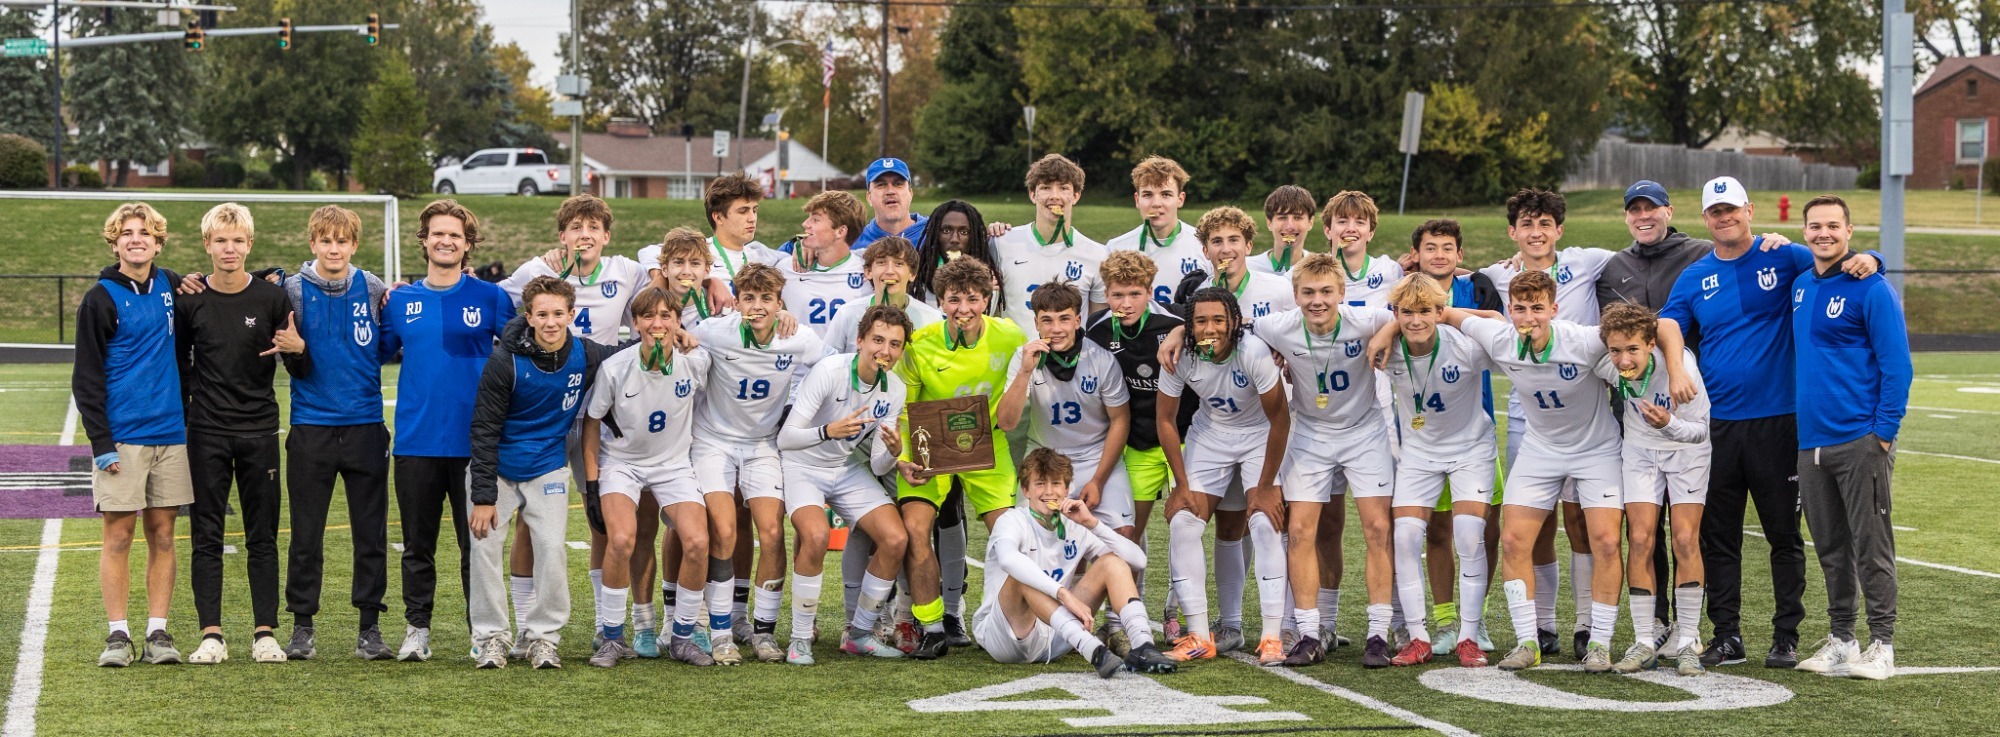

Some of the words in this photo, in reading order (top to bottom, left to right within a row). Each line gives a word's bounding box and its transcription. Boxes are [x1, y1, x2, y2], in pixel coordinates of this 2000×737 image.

[1702, 273, 1719, 290] CH
[161, 292, 173, 306] 29
[353, 302, 368, 317] 24
[406, 301, 422, 316] RD
[574, 307, 592, 335] 4
[1109, 341, 1121, 350] 33
[567, 373, 582, 387] 28
[736, 378, 771, 400] 19
[1317, 370, 1350, 394] 10
[1207, 397, 1242, 413] 21
[1413, 392, 1446, 413] 14
[1533, 390, 1565, 409] 11
[648, 410, 667, 433] 8
[1051, 401, 1082, 425] 13
